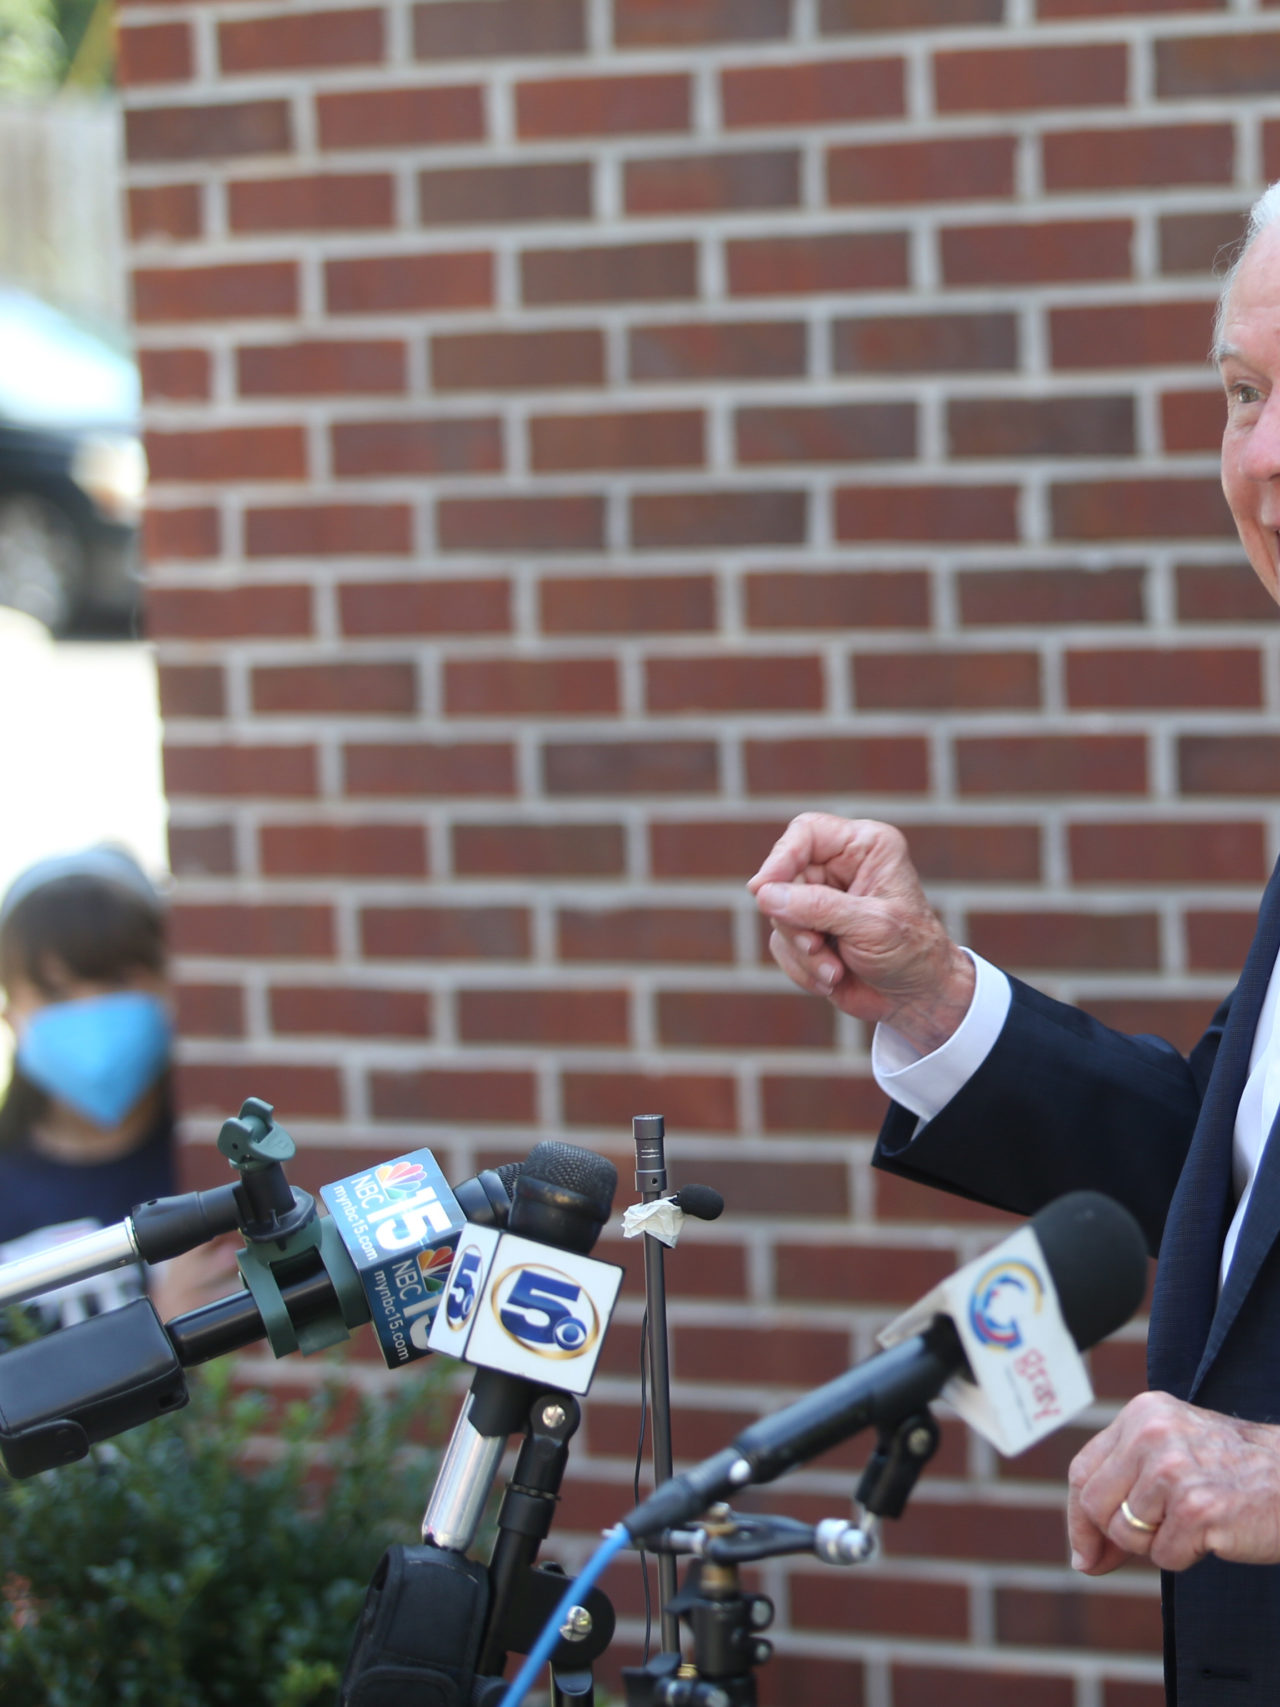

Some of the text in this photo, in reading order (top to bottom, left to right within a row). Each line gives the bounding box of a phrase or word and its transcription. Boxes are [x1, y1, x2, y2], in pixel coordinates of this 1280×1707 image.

[333, 1185, 378, 1260] mynbc15.com
[350, 1174, 452, 1250] NBC 15
[374, 1270, 409, 1360] mynbc15.com
[392, 1259, 422, 1300] NBC
[447, 1253, 482, 1320] 5
[501, 1269, 581, 1344] 5
[1014, 1348, 1061, 1422] gray
